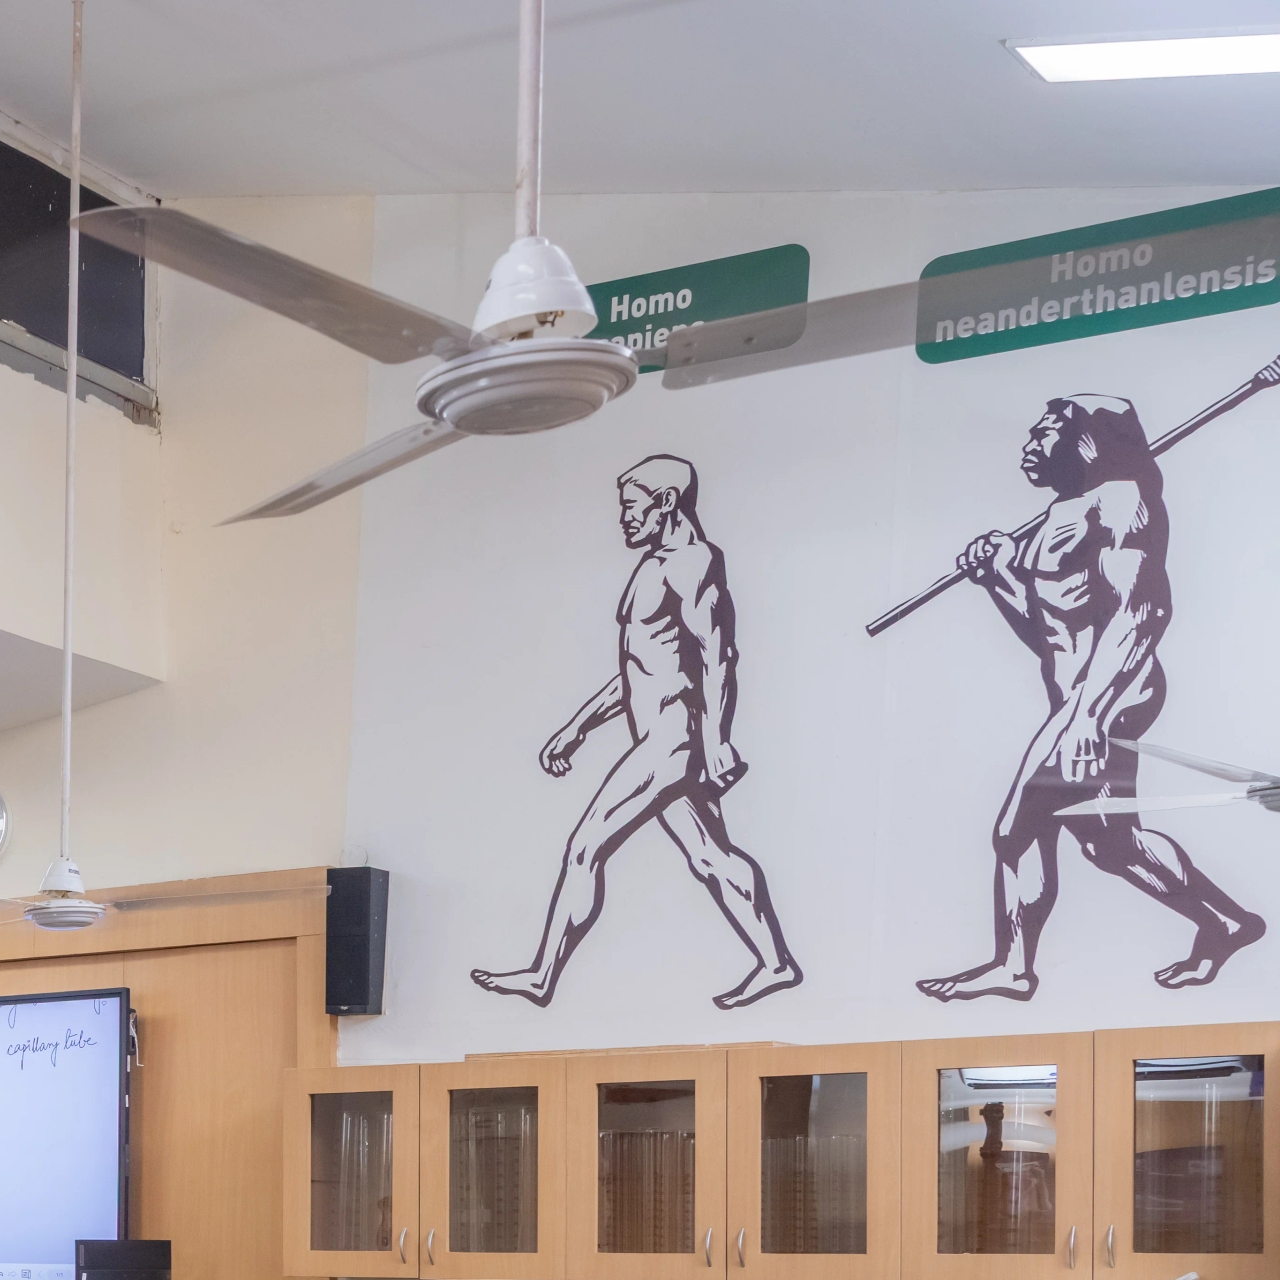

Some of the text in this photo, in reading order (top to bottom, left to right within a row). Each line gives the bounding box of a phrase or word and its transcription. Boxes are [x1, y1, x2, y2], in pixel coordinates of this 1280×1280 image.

[1051, 243, 1153, 283] Homo
[610, 288, 693, 323] Homo
[935, 255, 1278, 342] neanderthanlensis
[6, 1036, 60, 1070] capillary
[63, 1028, 99, 1050] tube
